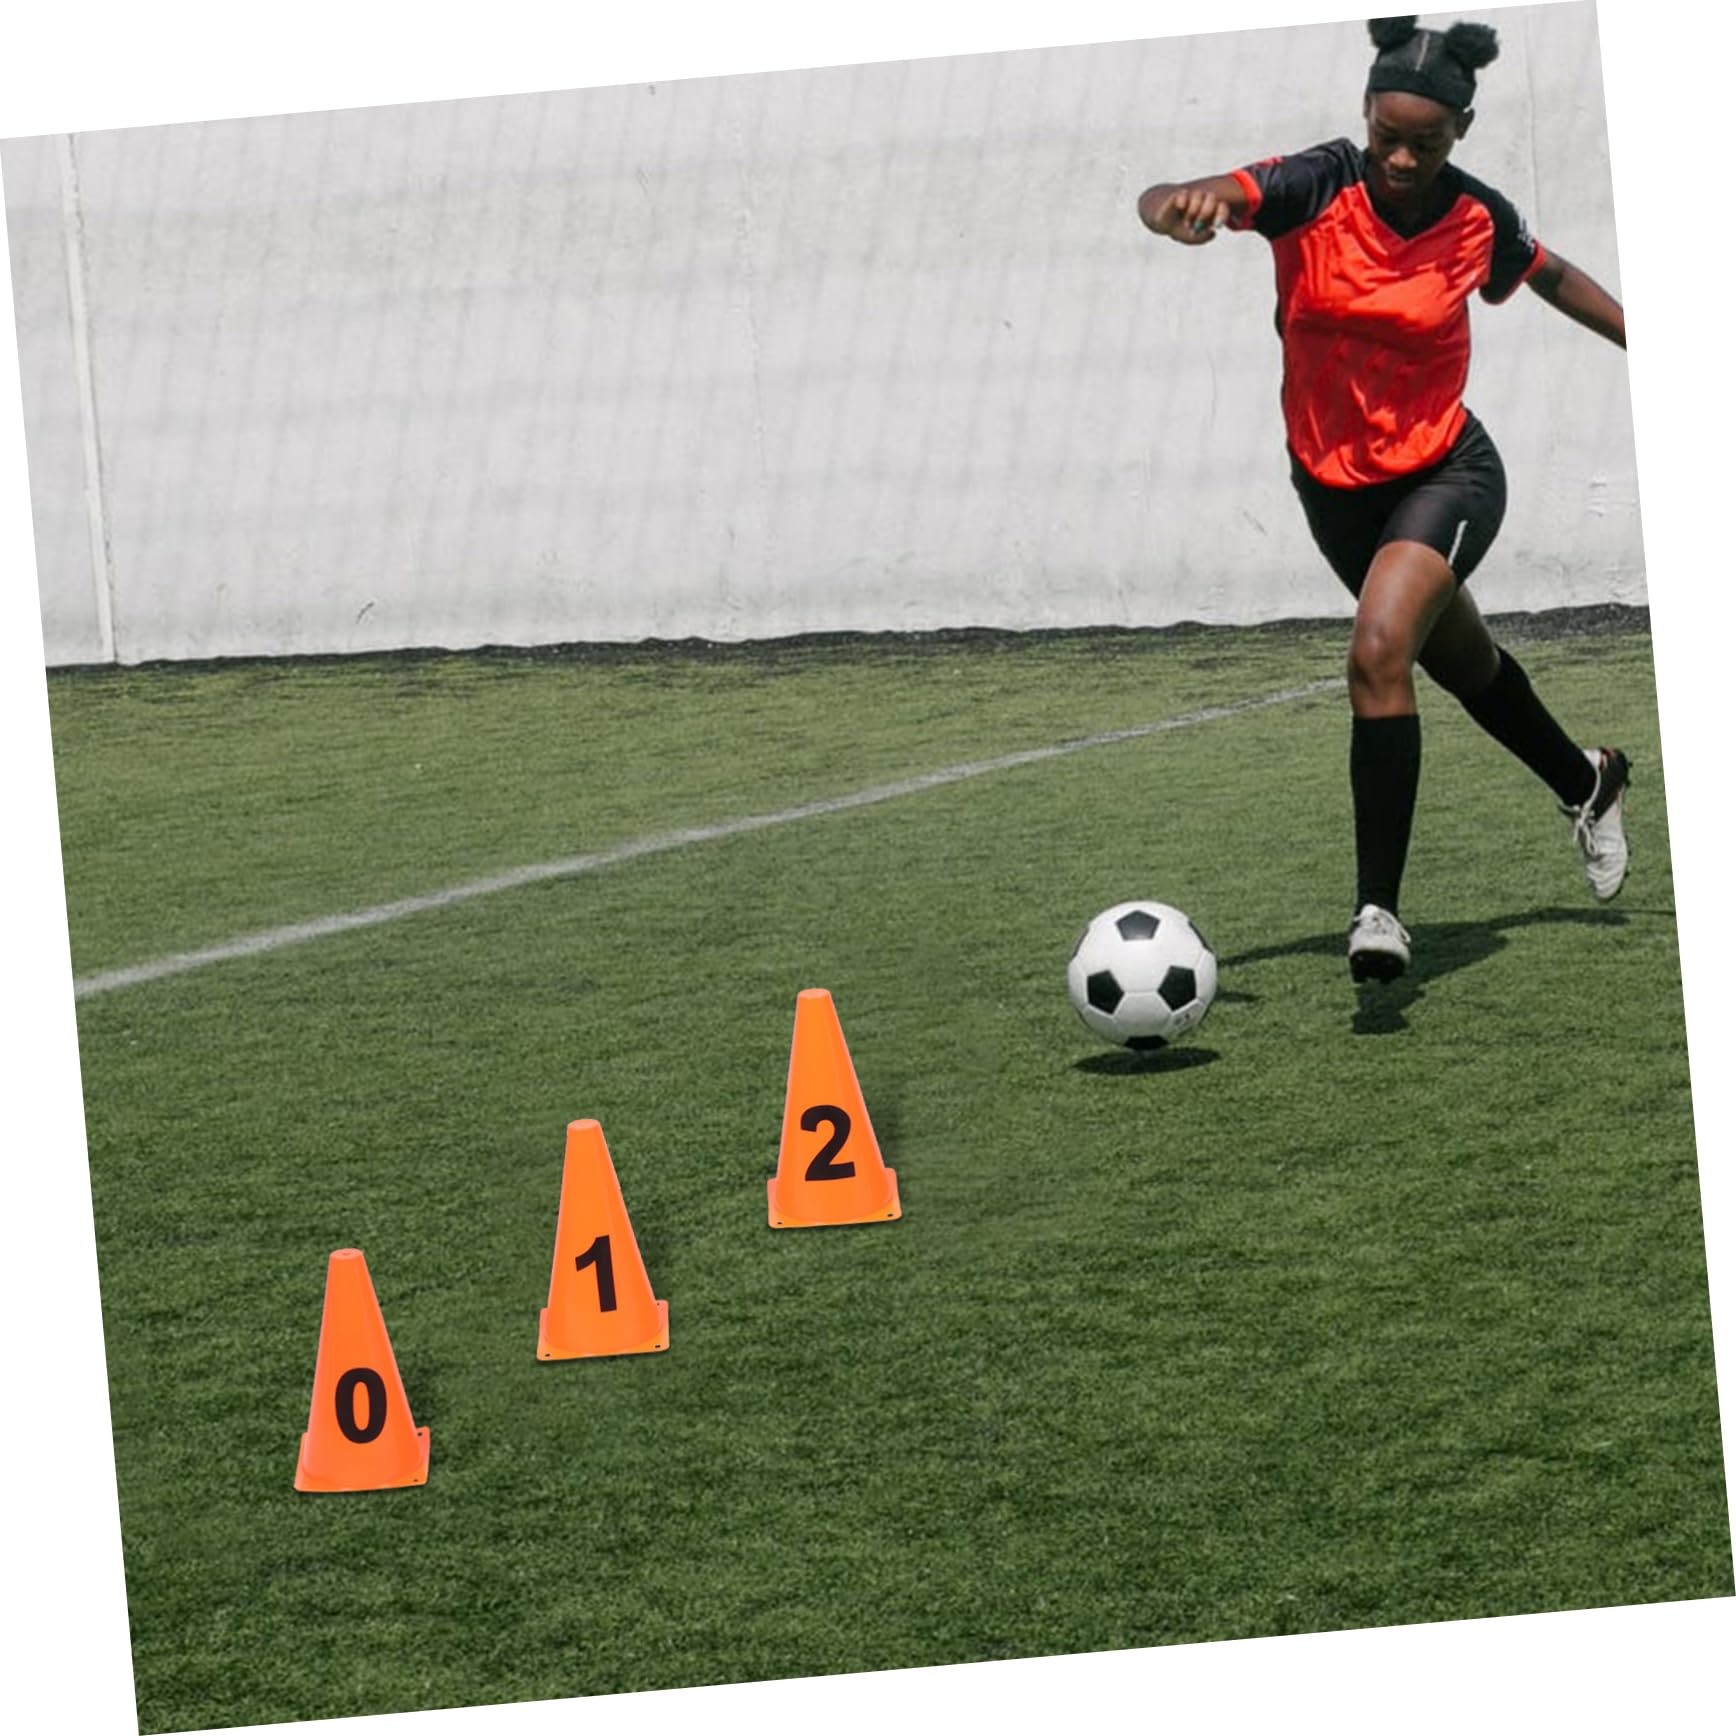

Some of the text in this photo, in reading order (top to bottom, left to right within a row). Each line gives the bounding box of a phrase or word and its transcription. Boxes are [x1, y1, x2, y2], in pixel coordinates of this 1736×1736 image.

[800, 1105, 856, 1181] 2
[575, 1235, 617, 1313] 1
[334, 1367, 387, 1444] 0
